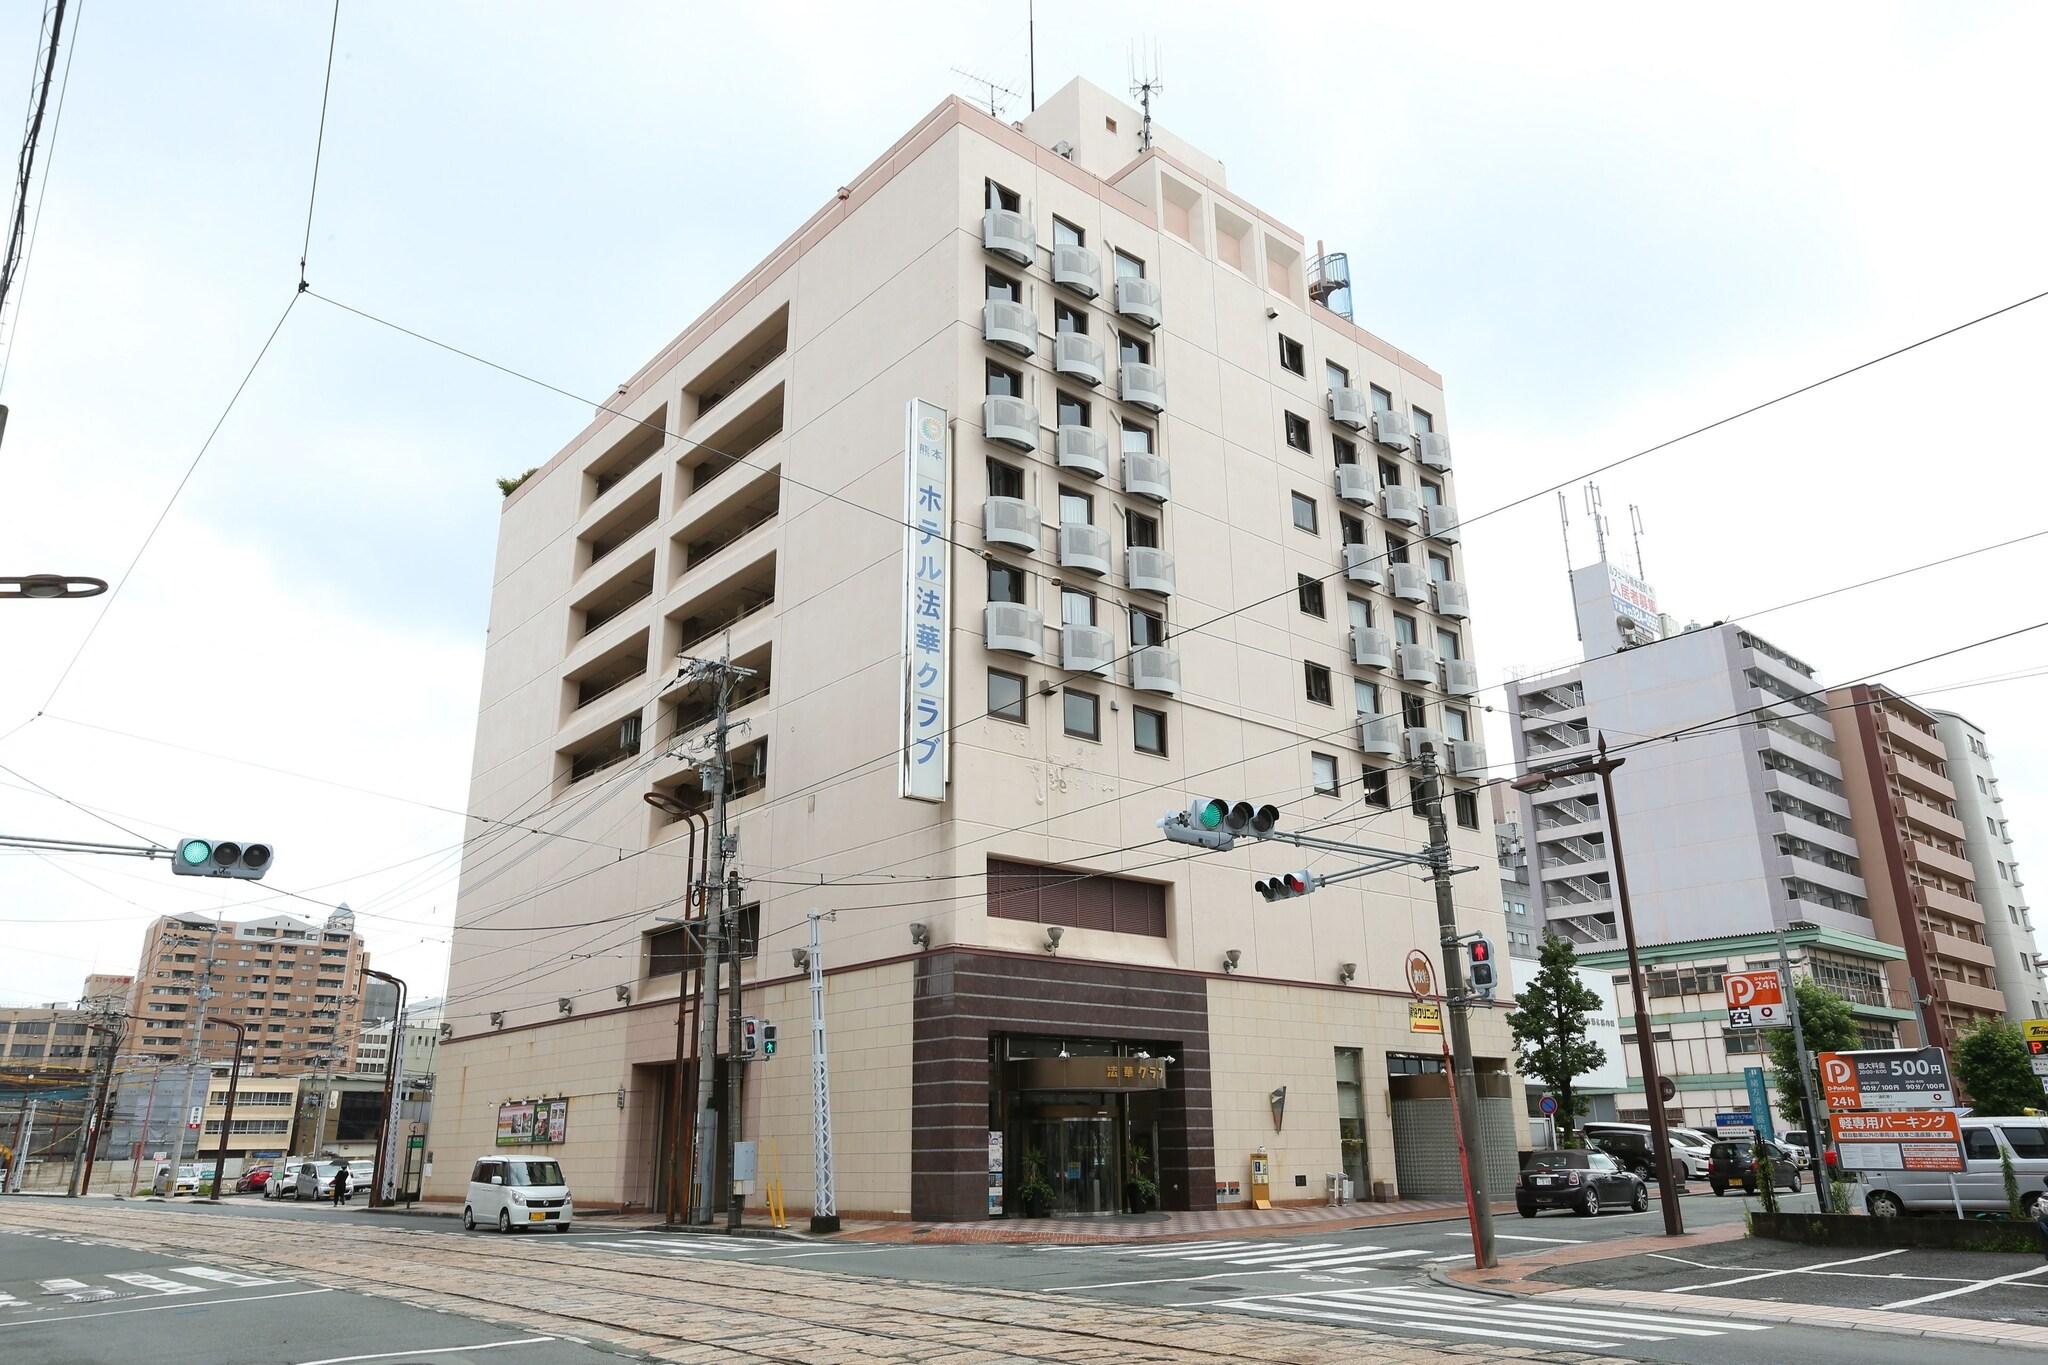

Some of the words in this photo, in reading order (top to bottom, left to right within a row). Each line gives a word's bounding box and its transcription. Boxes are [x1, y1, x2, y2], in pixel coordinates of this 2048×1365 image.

[919, 443, 943, 462] 熊本
[1611, 578, 1658, 614] 入居者募集
[915, 484, 942, 765] ホテル法華クラブ
[1755, 981, 1777, 990] 24h
[1729, 1007, 1753, 1027] 空
[1890, 1059, 1942, 1076] 500円
[1831, 1096, 1856, 1107] 24h
[1838, 1115, 1946, 1130] 軽専用パーキング
